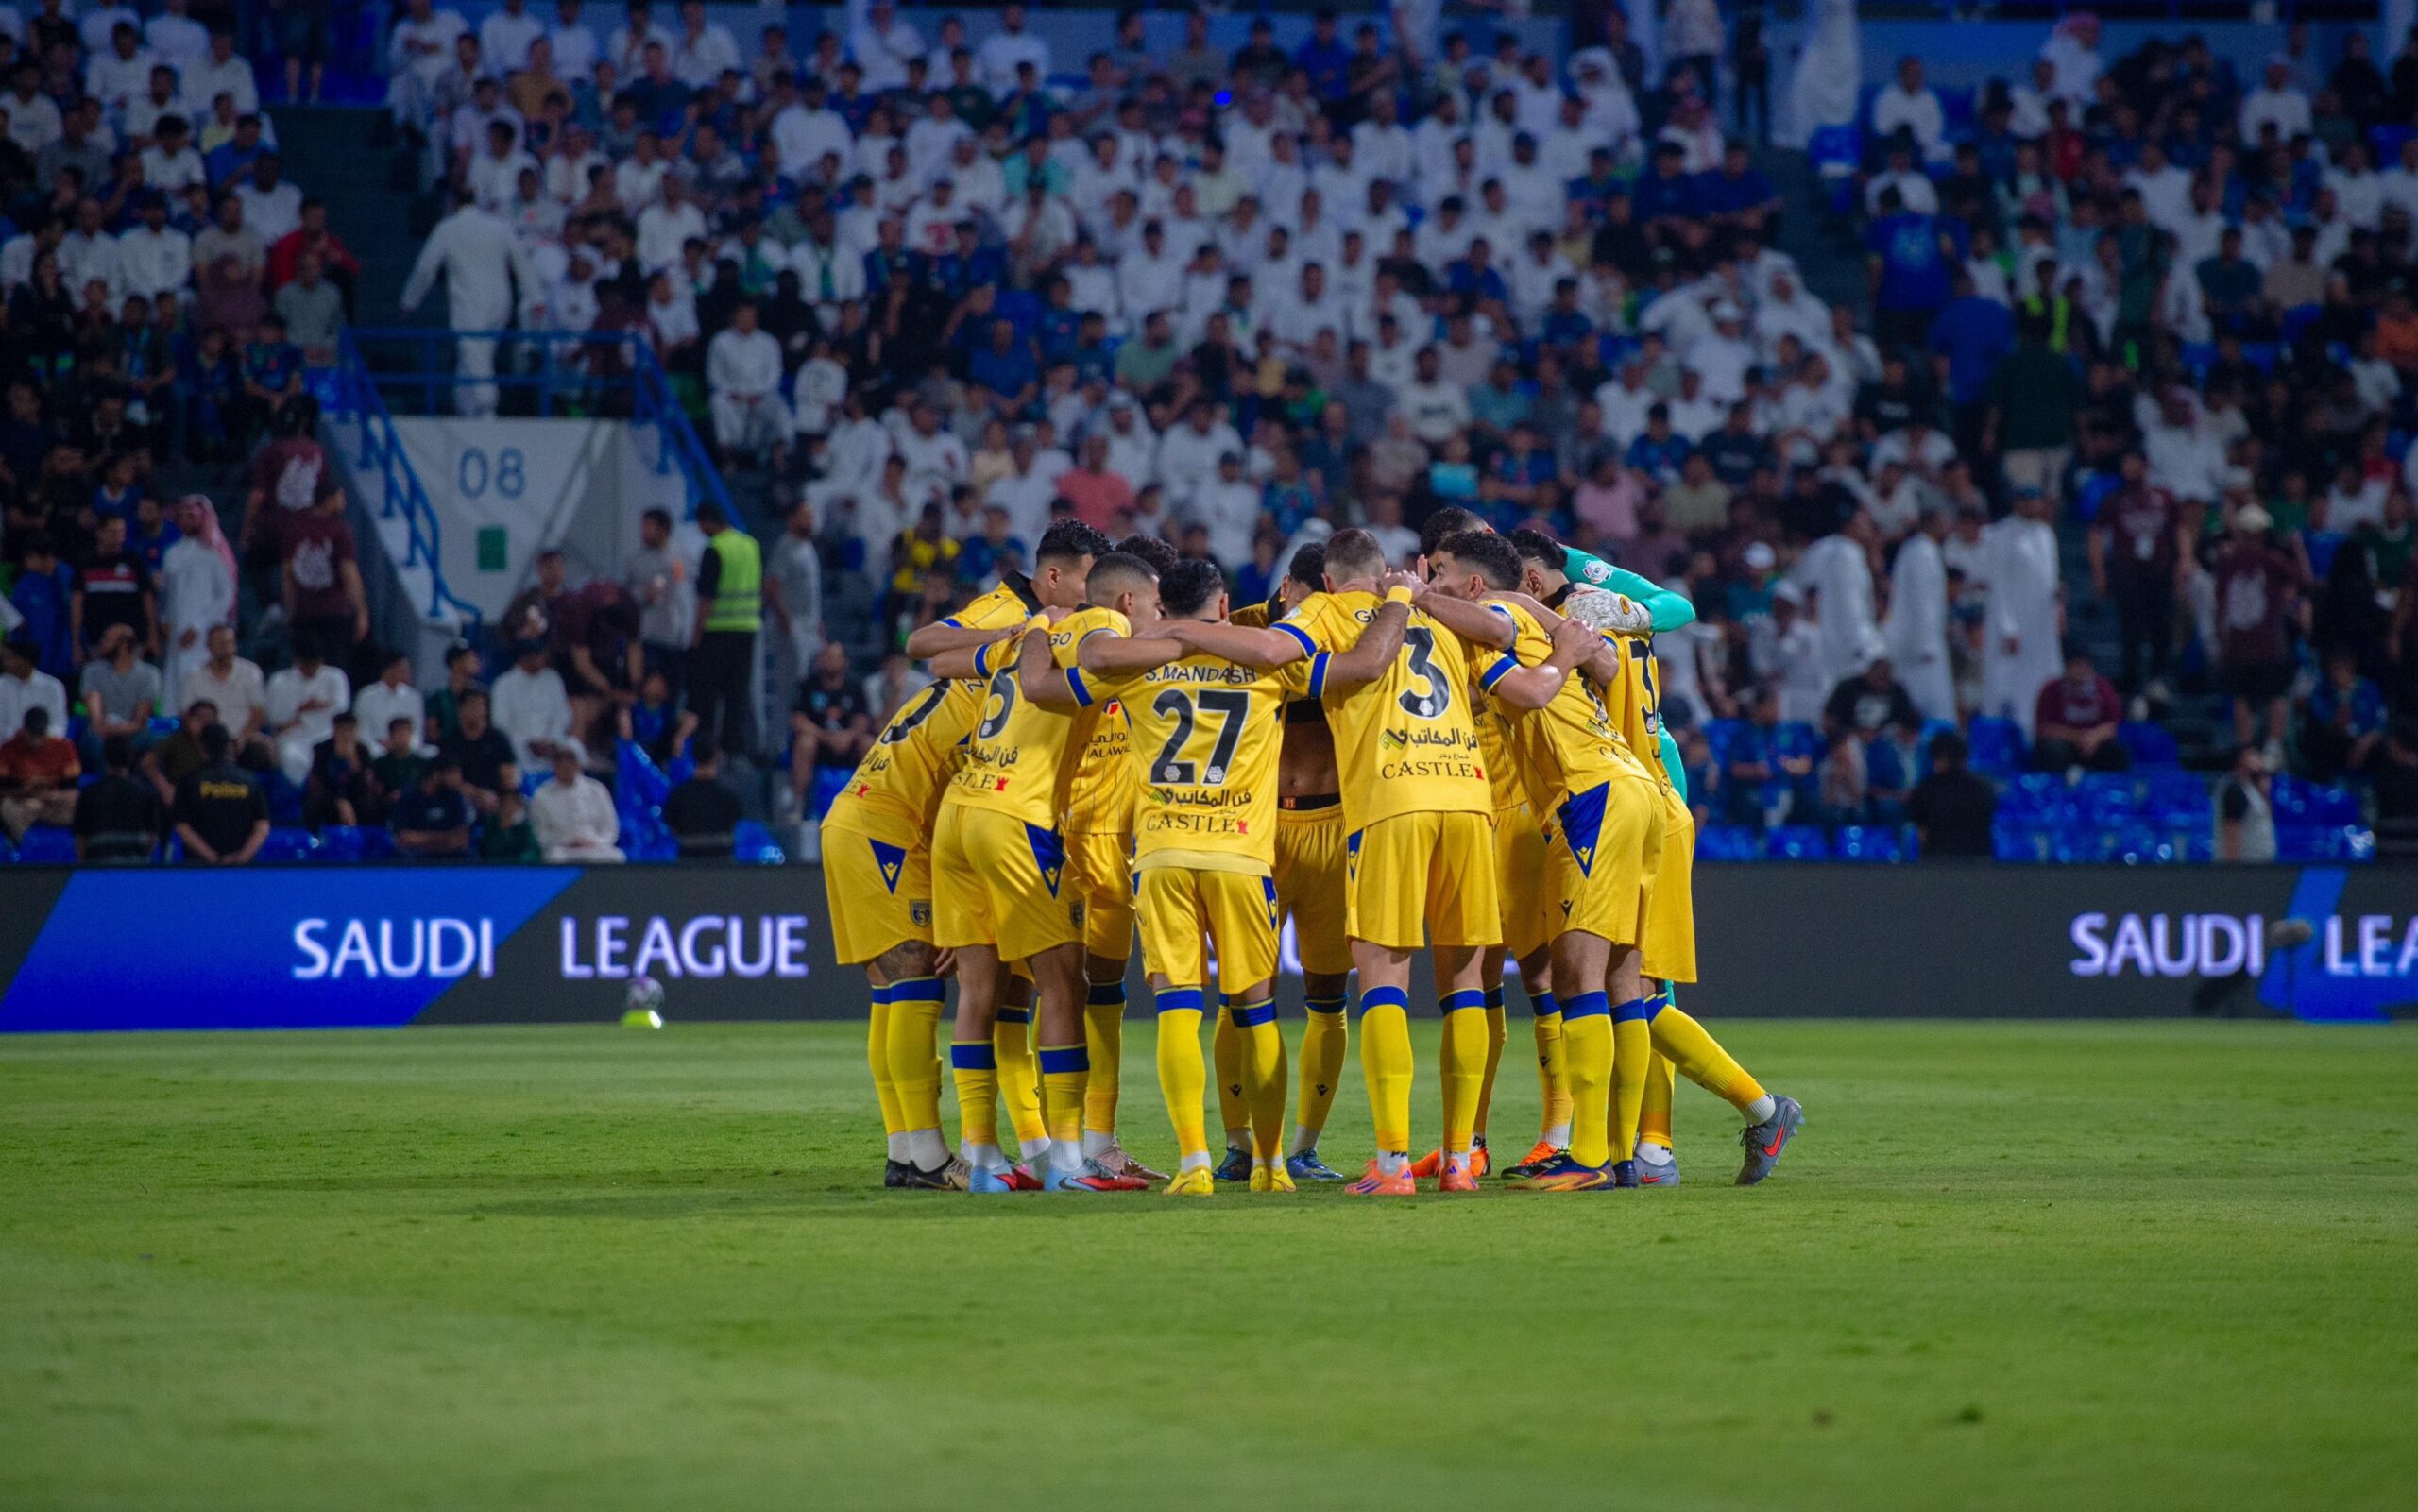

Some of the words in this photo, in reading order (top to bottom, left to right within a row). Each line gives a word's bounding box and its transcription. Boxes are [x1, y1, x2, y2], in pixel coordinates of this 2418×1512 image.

[459, 446, 525, 499] 08
[1145, 665, 1257, 684] S.MANDASH
[1398, 627, 1449, 719] 3
[1149, 688, 1251, 786] 27
[1382, 761, 1473, 779] CASTLE
[1147, 813, 1235, 833] CASTLE
[293, 916, 494, 979] SAUDI
[560, 915, 809, 978] LEAGUE
[2070, 912, 2264, 977] SAUDI
